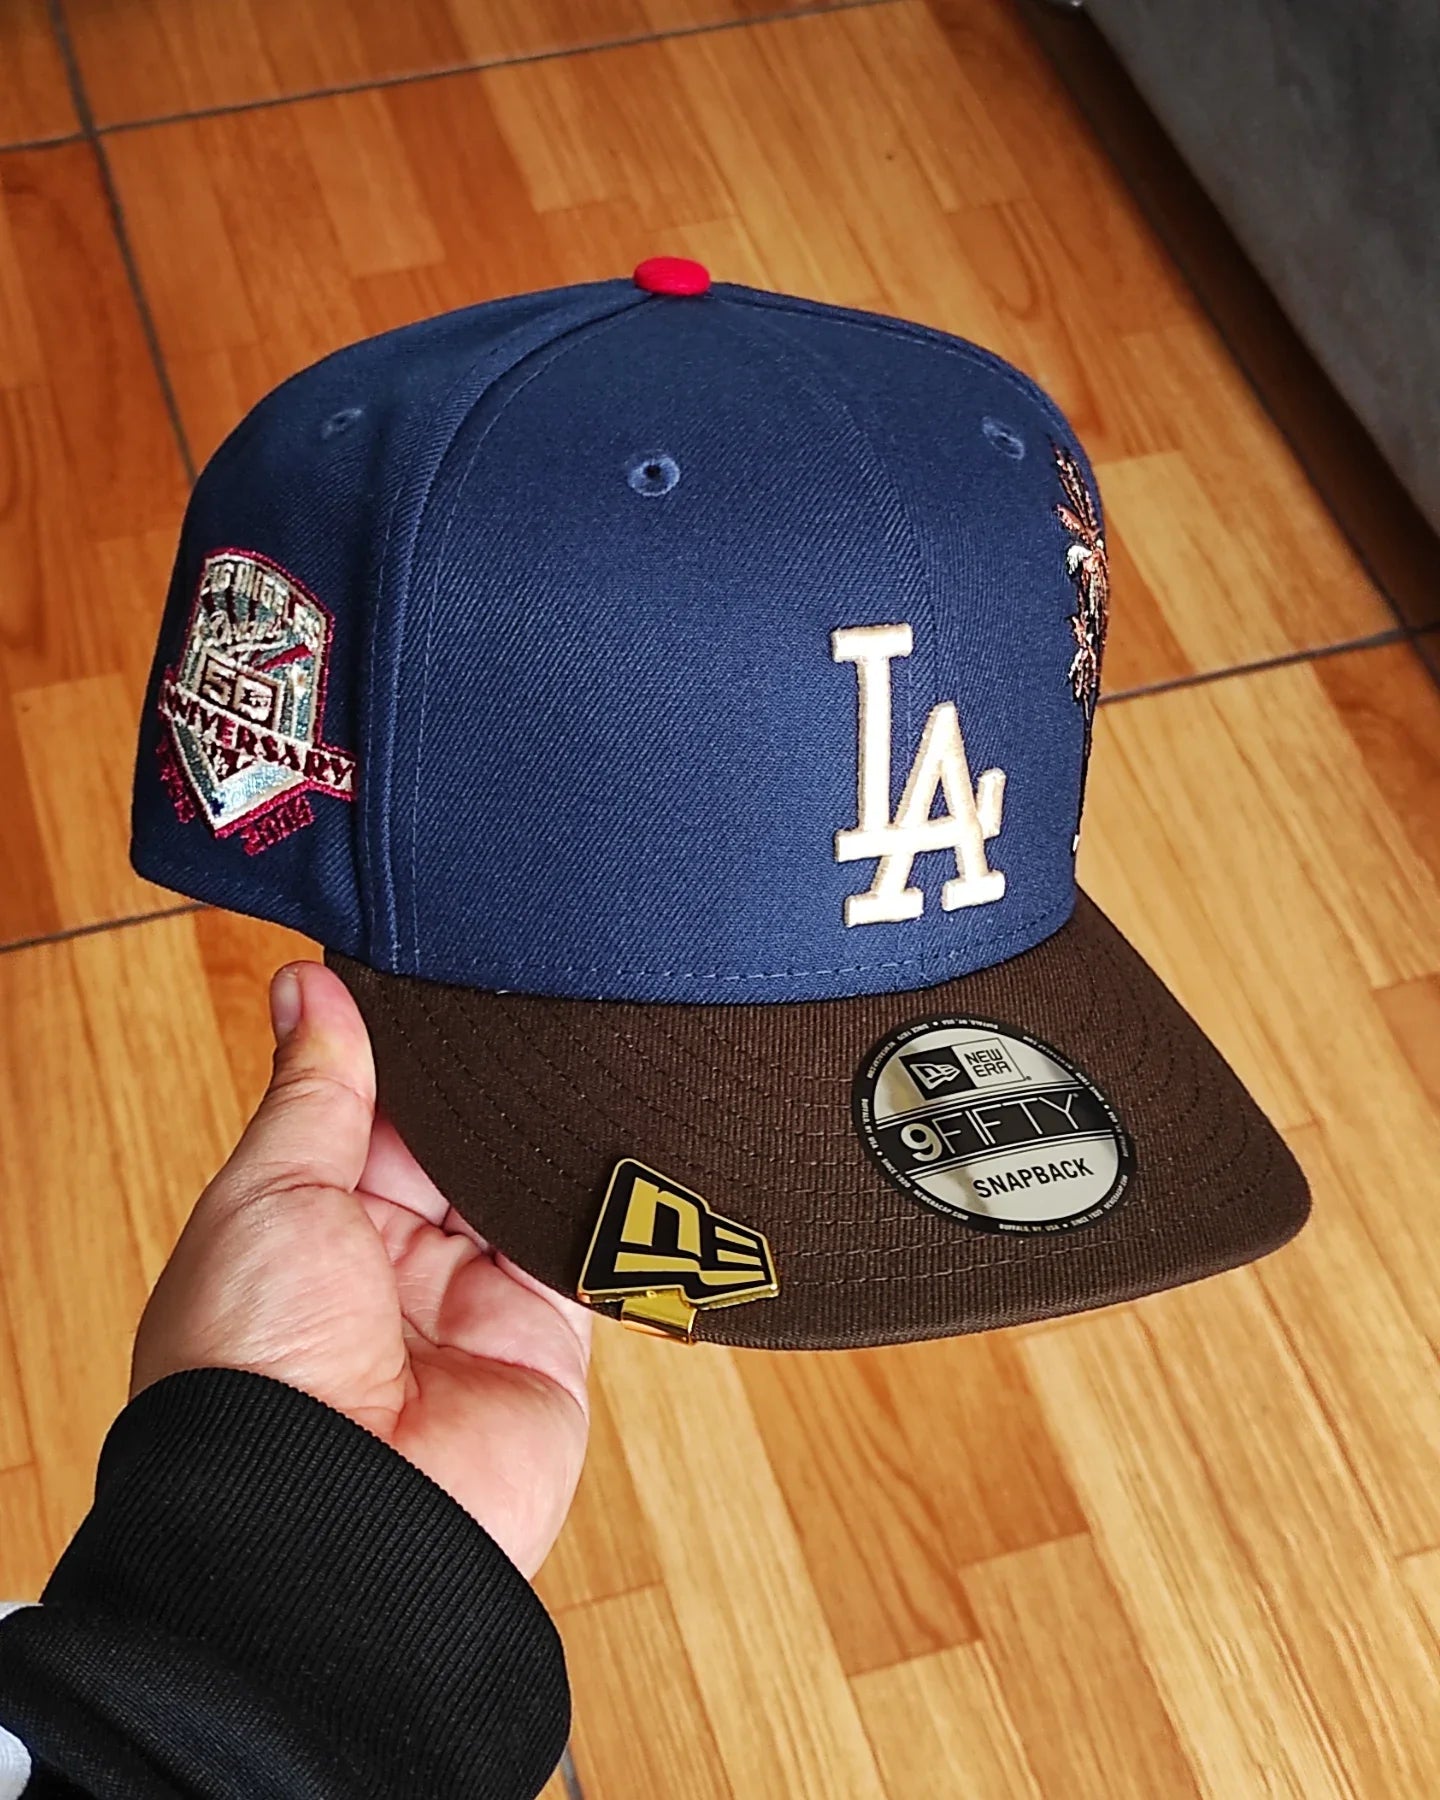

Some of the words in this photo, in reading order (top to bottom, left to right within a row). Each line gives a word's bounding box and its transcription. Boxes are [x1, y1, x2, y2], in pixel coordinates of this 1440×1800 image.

[831, 623, 1007, 928] LA
[963, 1047, 1003, 1066] NEW
[973, 1060, 1012, 1078] ERA
[899, 1093, 1079, 1162] 9FIFTY
[973, 1158, 1095, 1199] SNAPBACK
